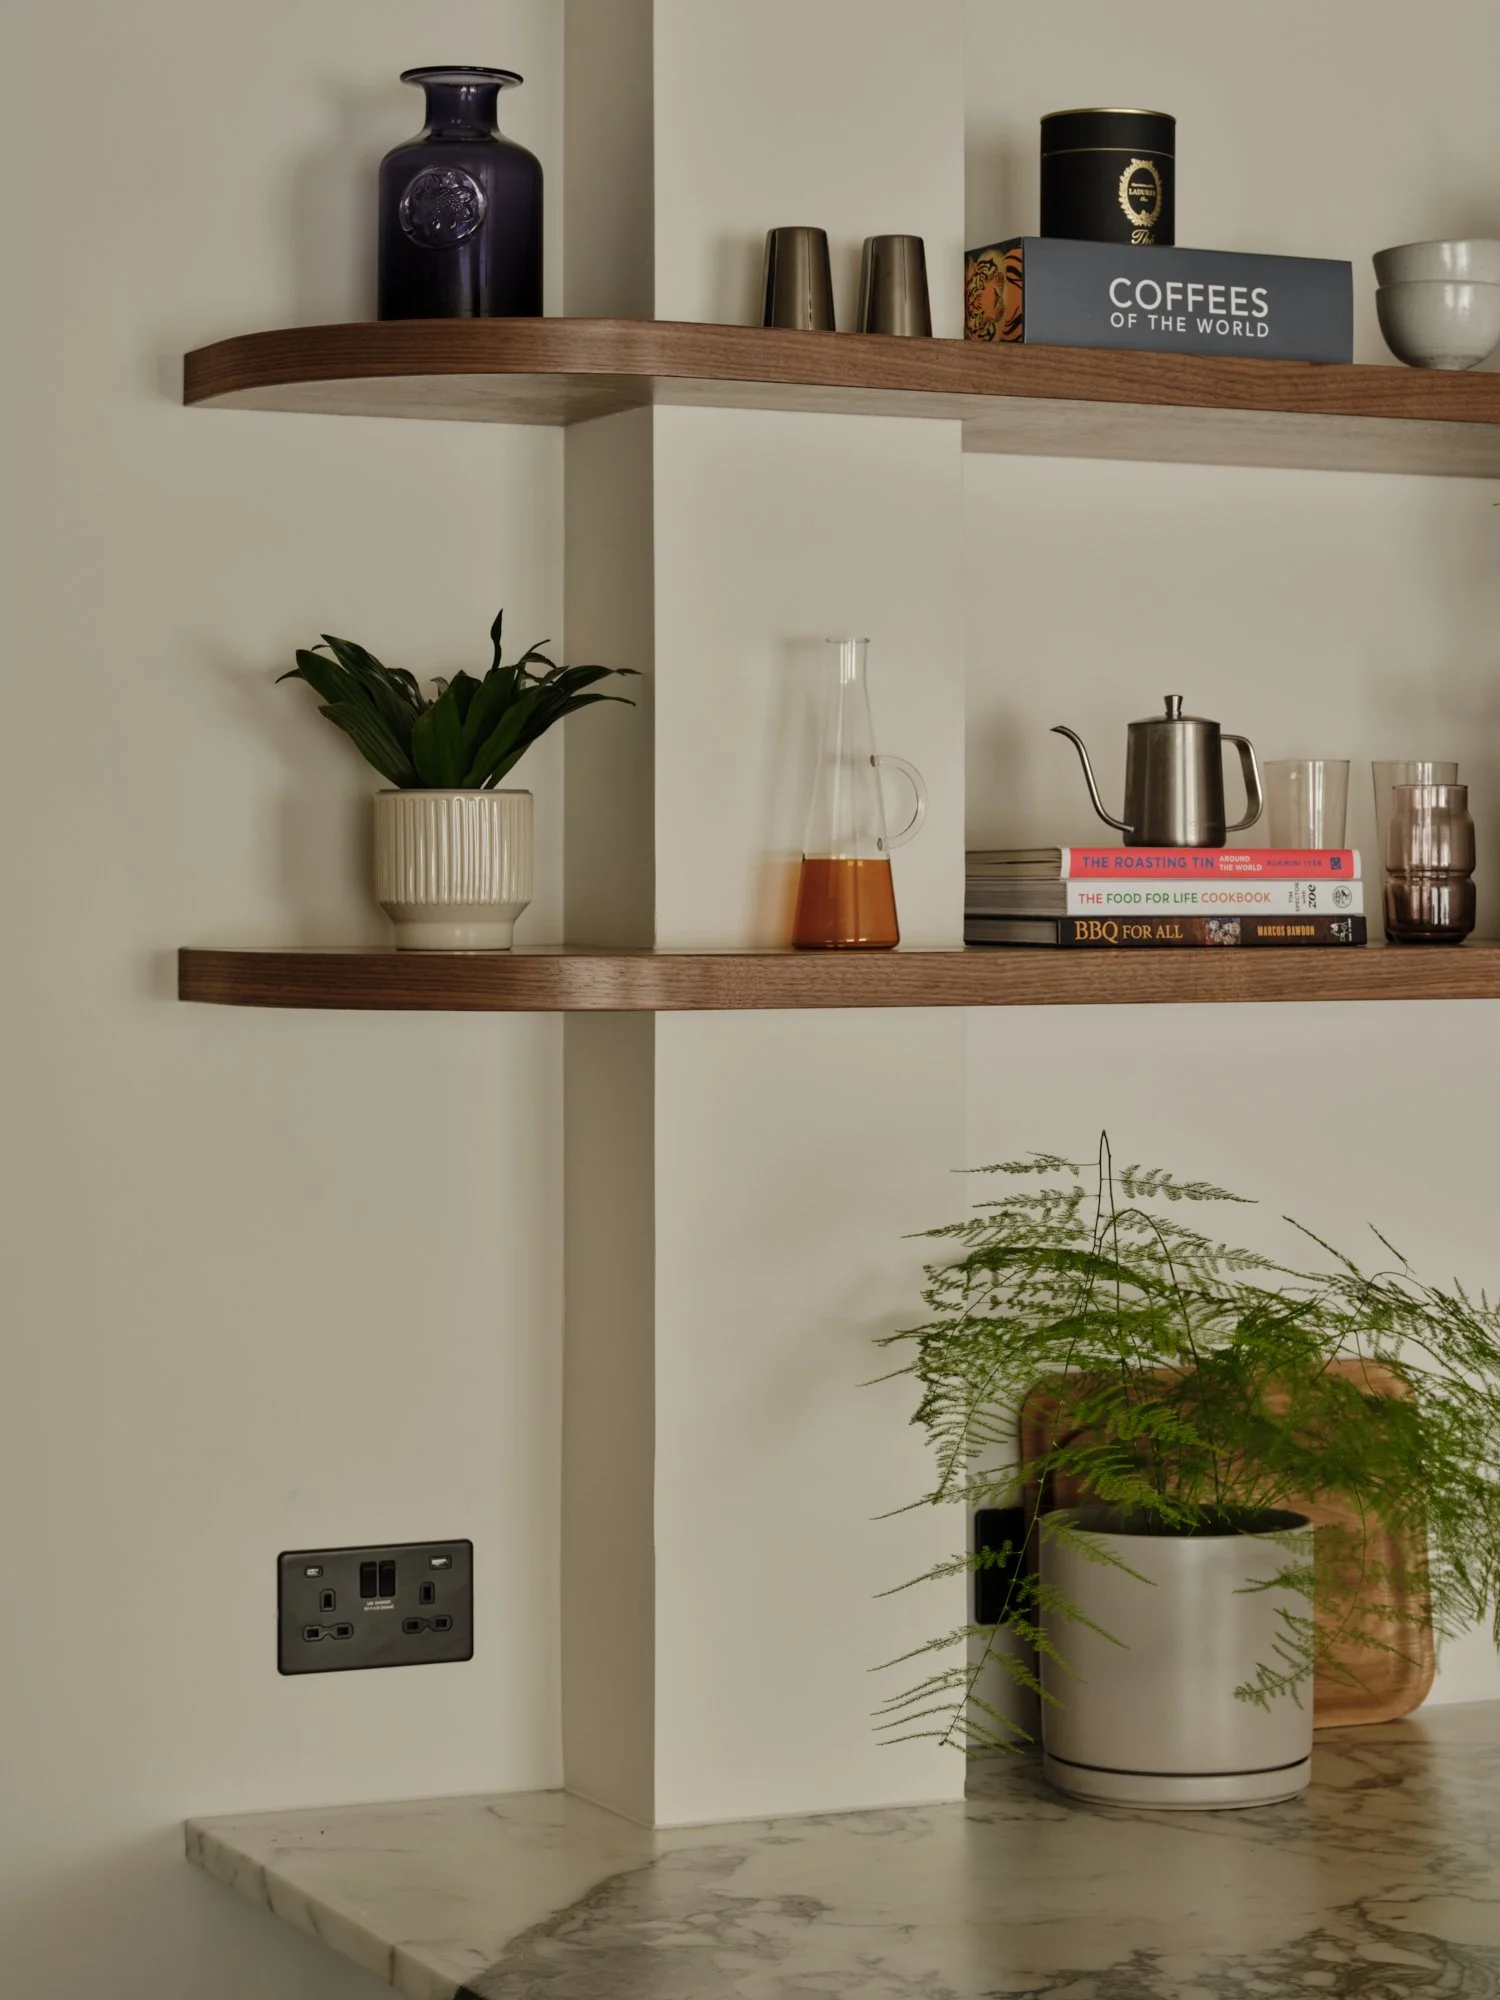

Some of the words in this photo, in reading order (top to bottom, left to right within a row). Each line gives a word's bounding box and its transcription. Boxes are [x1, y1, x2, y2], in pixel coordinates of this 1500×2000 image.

[1109, 277, 1270, 318] COFFEES
[1110, 312, 1138, 329] OF
[1148, 314, 1187, 332] THE
[1196, 317, 1270, 338] WORLD
[1082, 856, 1110, 868] THE
[1114, 856, 1187, 868] ROASTING
[1192, 856, 1214, 868] TIN
[1079, 893, 1103, 904] THE
[1106, 893, 1142, 904] FOOD
[1145, 893, 1170, 904] FOR
[1173, 893, 1199, 903] LIFE
[1201, 892, 1272, 903] COOKBOOK
[1308, 884, 1317, 909] zoe
[1075, 920, 1119, 944] BBQ
[1122, 924, 1153, 939] FOR
[1156, 924, 1184, 939] ALL
[1257, 925, 1286, 937] MARCUS
